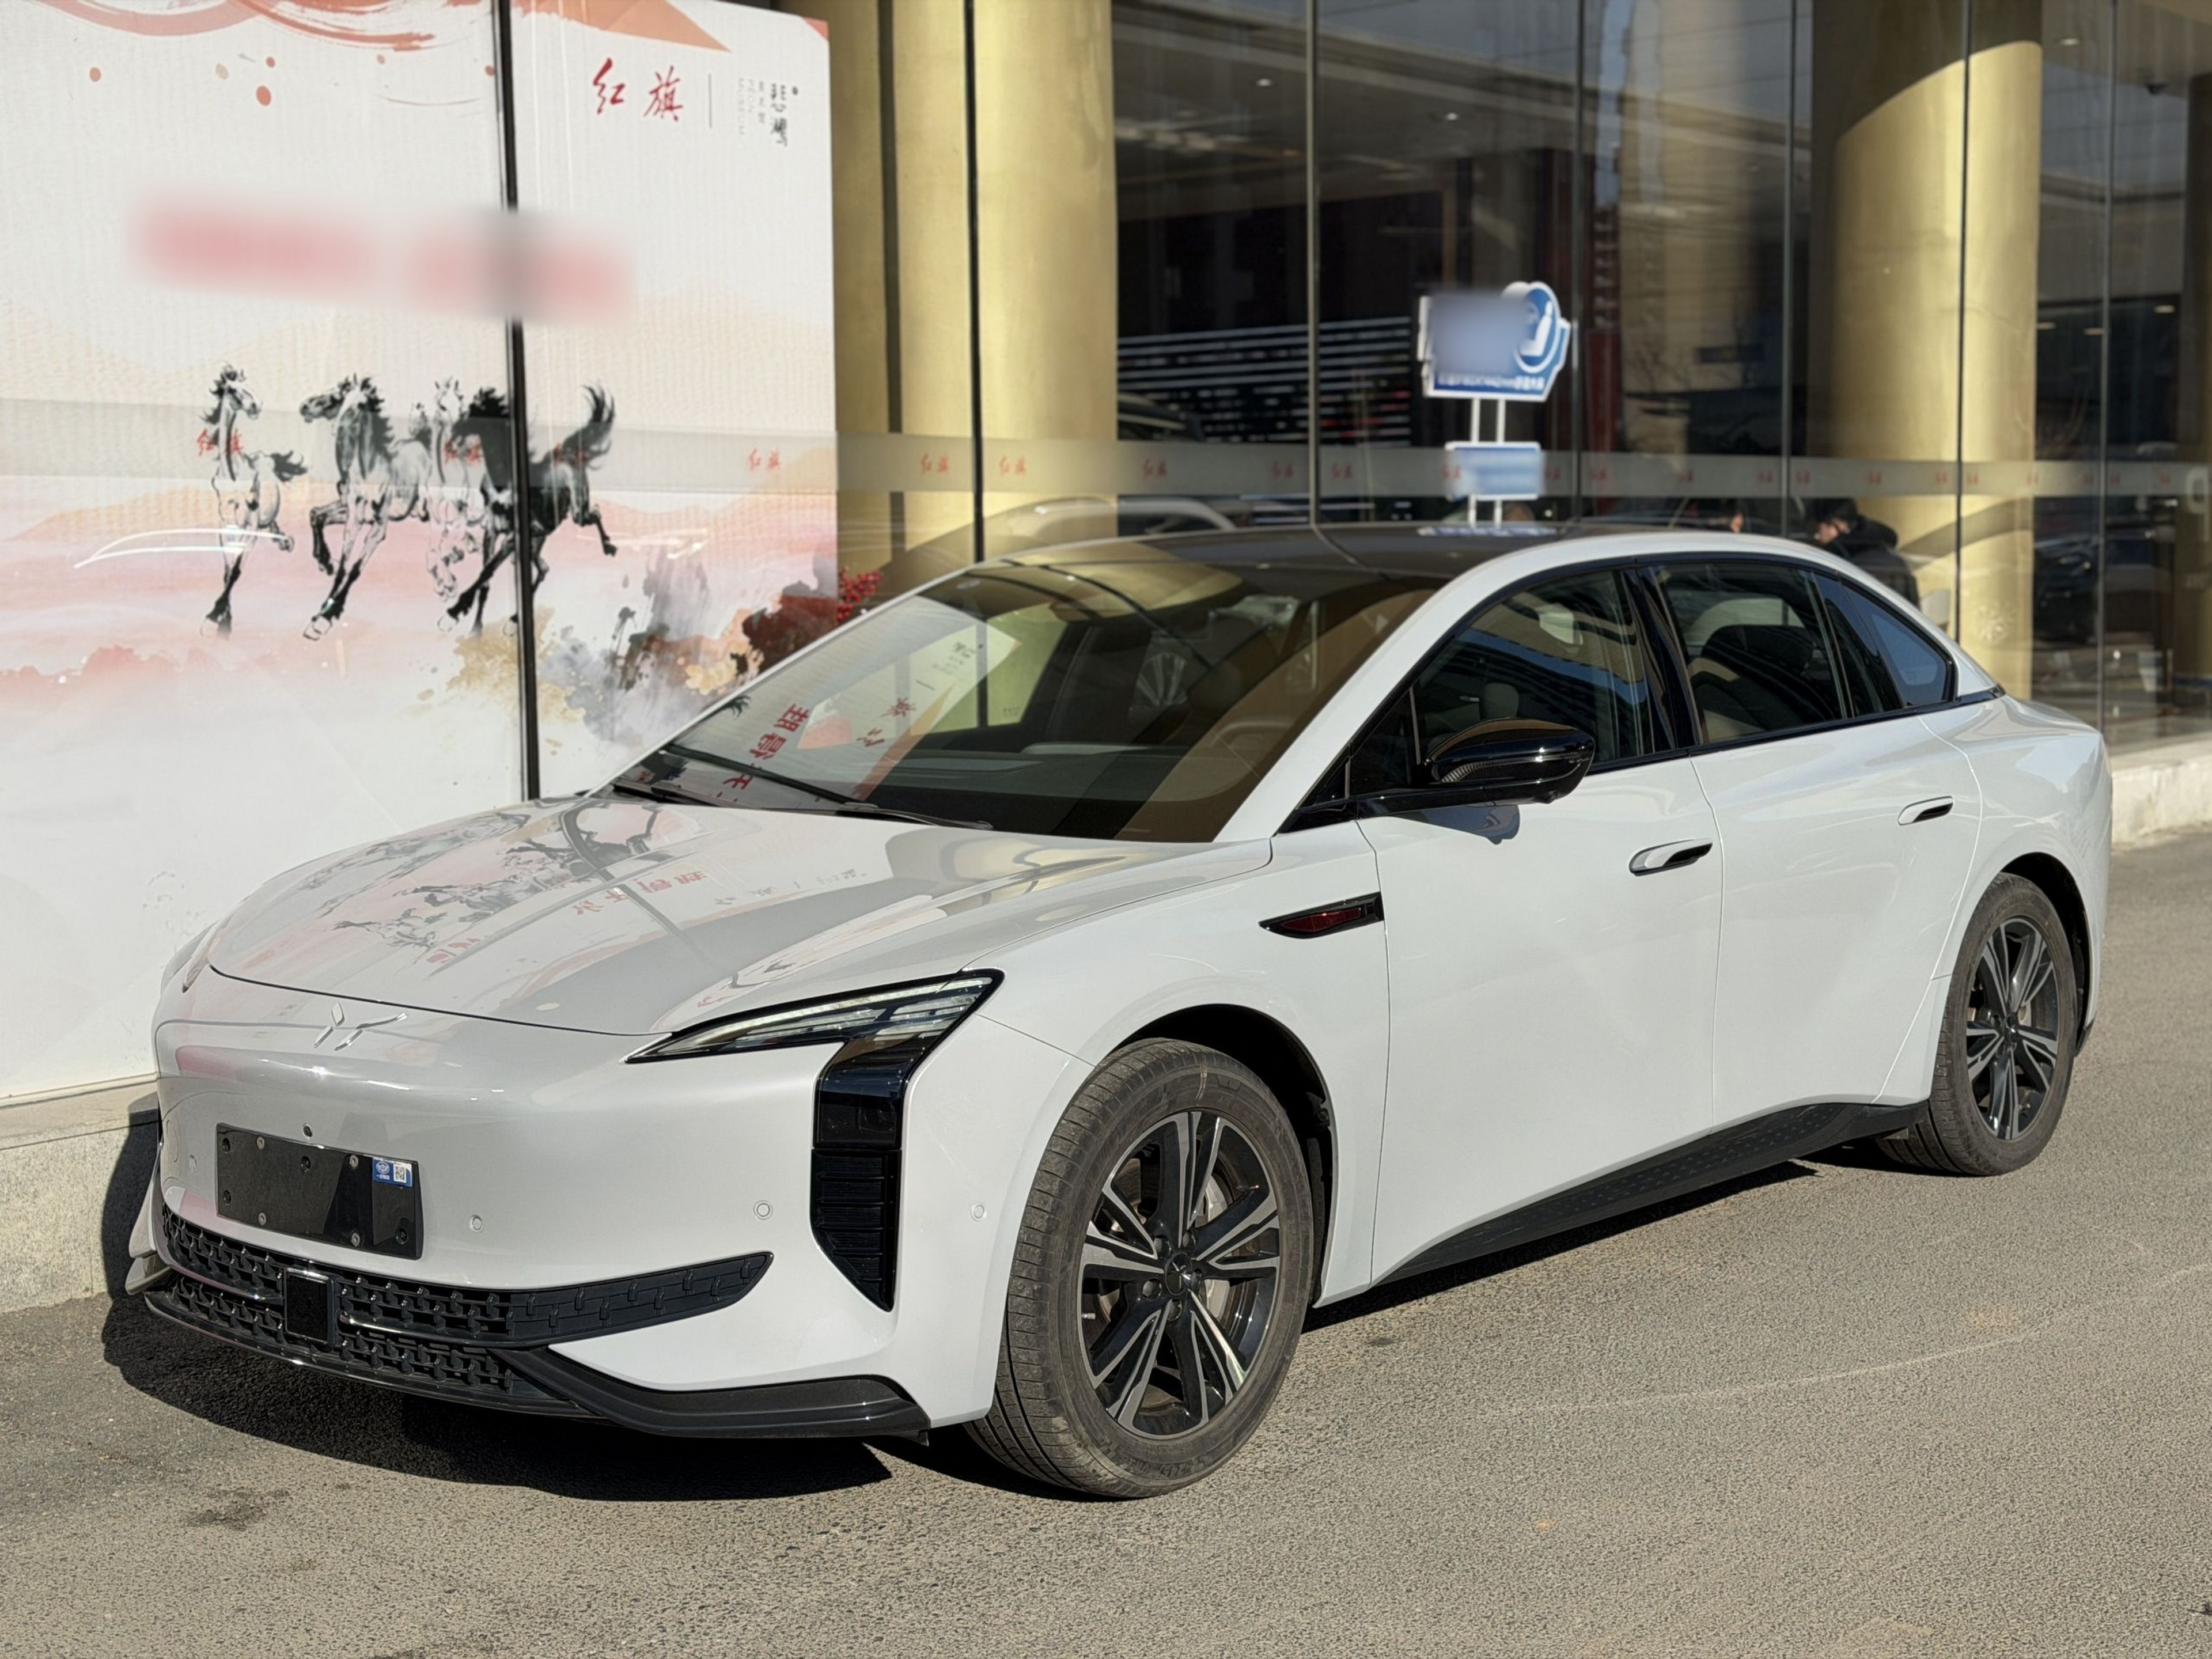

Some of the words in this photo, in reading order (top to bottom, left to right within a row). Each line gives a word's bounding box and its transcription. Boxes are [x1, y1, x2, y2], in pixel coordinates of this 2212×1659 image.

[593, 57, 684, 121] 红旗
[748, 447, 781, 471] 红旗
[921, 452, 949, 475] 红旗
